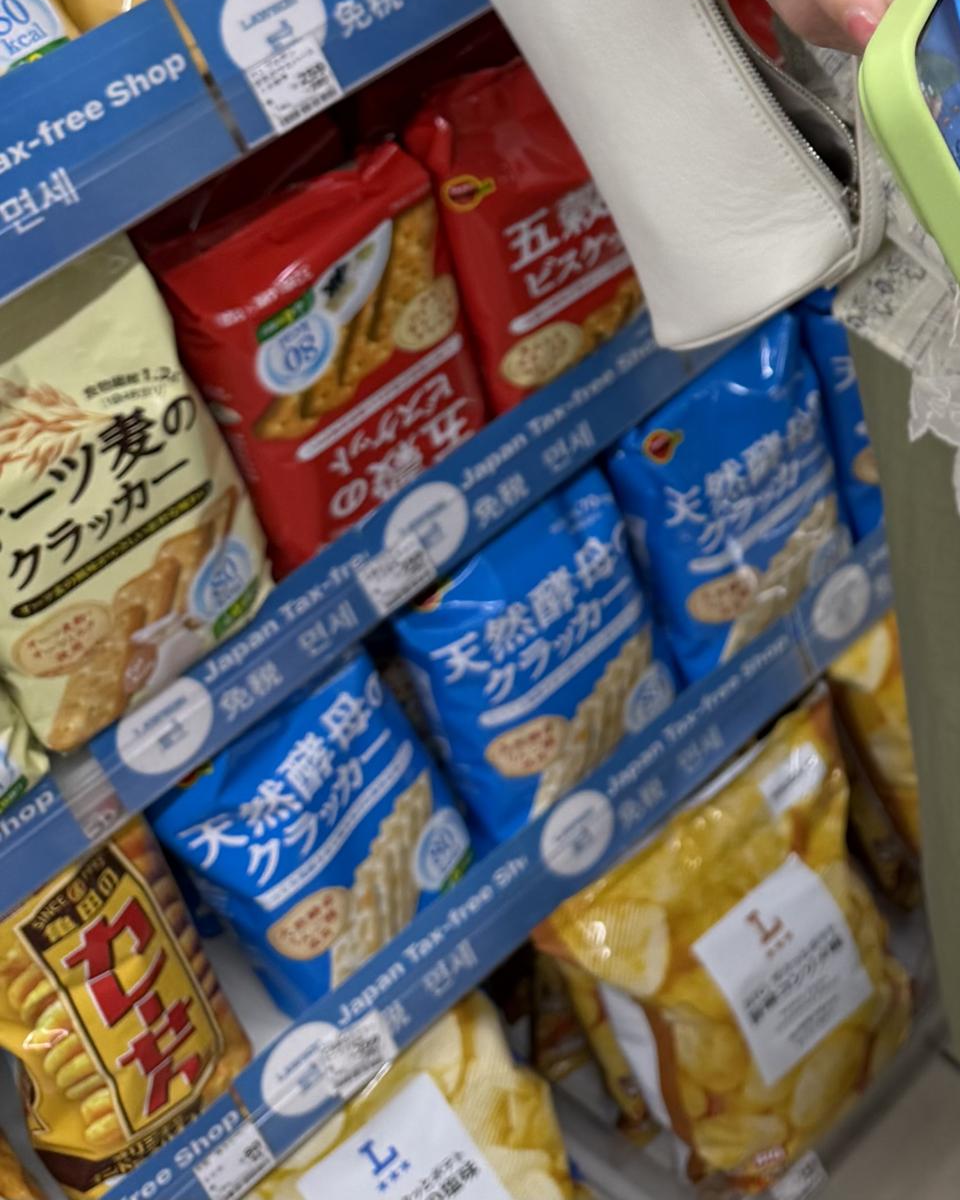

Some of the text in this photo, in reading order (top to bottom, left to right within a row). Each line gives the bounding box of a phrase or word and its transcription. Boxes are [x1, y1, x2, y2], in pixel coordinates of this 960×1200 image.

[3, 22, 48, 57] kcal
[106, 52, 188, 109] Shop
[0, 166, 81, 235] 면세
[0, 394, 198, 533] ーツ麦の
[461, 427, 528, 489] Japan
[527, 374, 613, 437] Tax-free
[8, 457, 190, 592] クラッカー
[203, 618, 280, 684] Japan
[483, 574, 634, 704] クラッカー
[178, 670, 385, 870] 天然酵母の
[245, 728, 393, 888] クラッカー
[338, 958, 406, 1025] Japan
[403, 878, 496, 962] Tax-free
[173, 1110, 240, 1168] Shop
[358, 1140, 398, 1176] L
